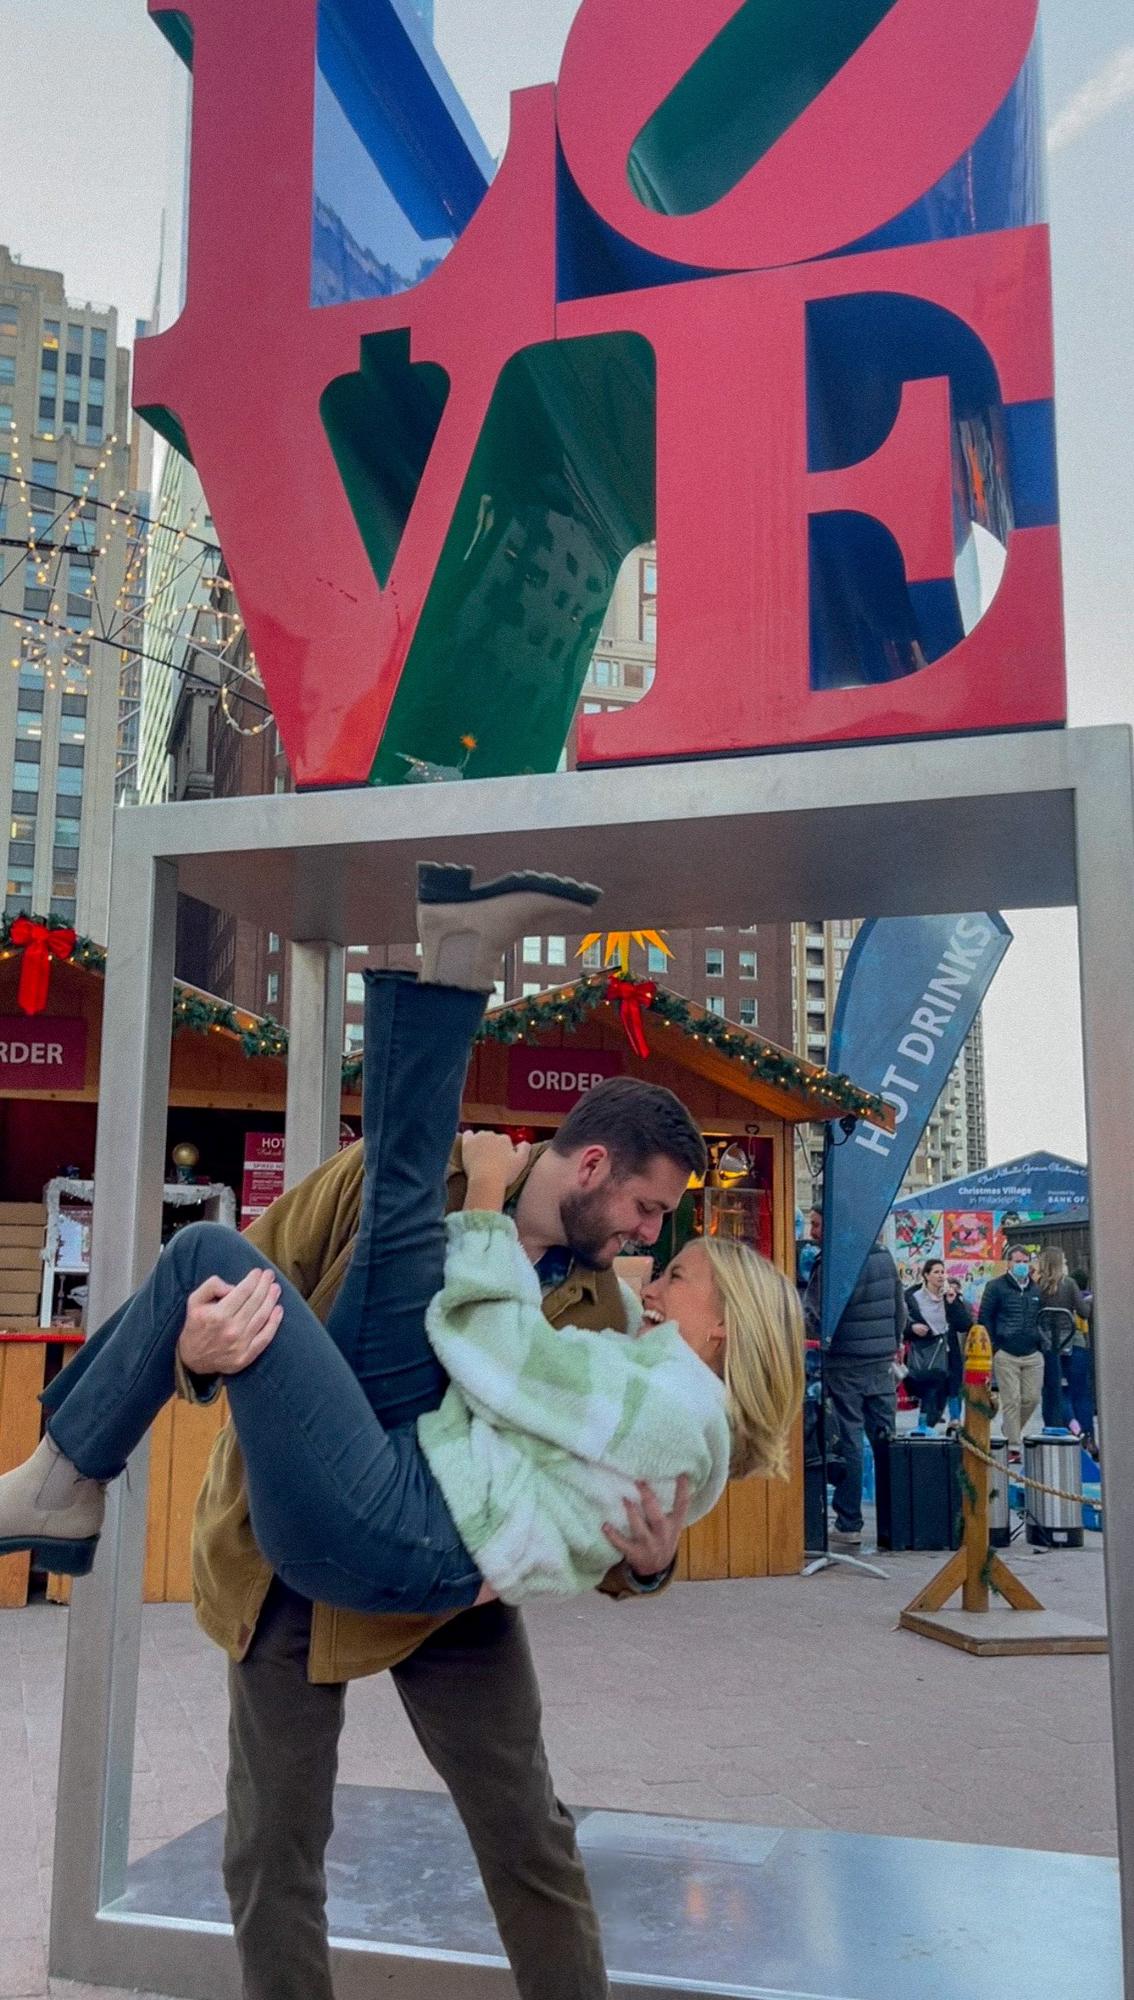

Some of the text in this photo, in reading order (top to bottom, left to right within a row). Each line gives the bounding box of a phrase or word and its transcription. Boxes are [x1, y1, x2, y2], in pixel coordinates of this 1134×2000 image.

[855, 916, 992, 1157] HOT DRINKS
[958, 1187, 1032, 1197] Christmas Village
